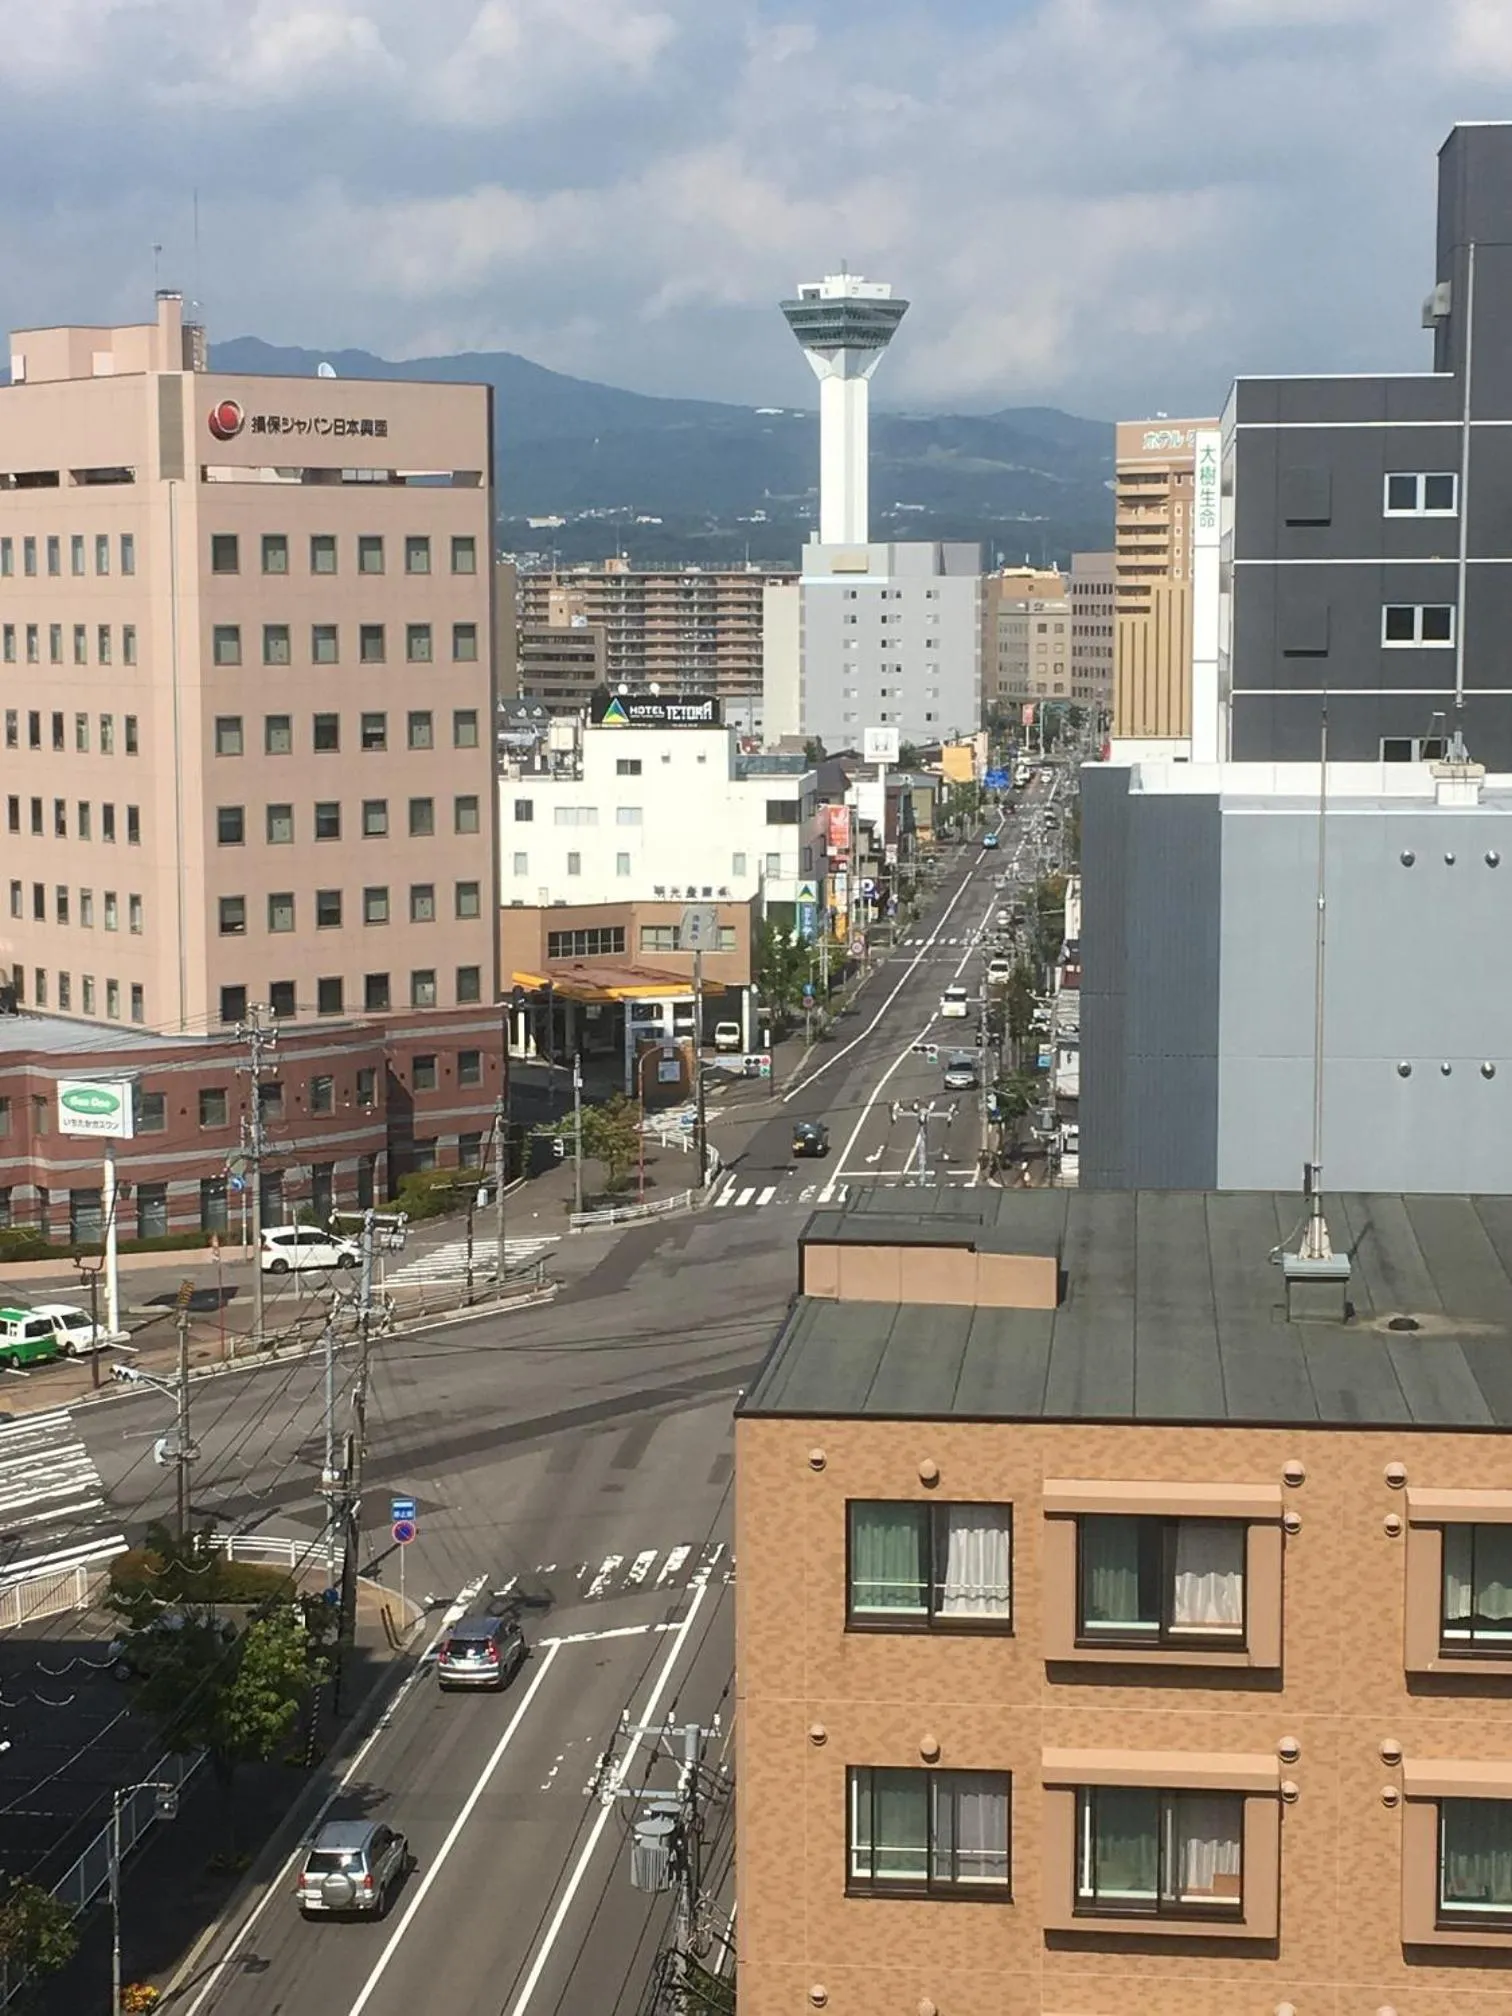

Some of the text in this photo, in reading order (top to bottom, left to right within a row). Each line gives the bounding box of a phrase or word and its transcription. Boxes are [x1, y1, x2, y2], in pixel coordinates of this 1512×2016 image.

[252, 416, 387, 437] 損保ジャパン日本興亜
[1199, 444, 1216, 528] 大樹生命
[629, 705, 665, 714] HOTEL
